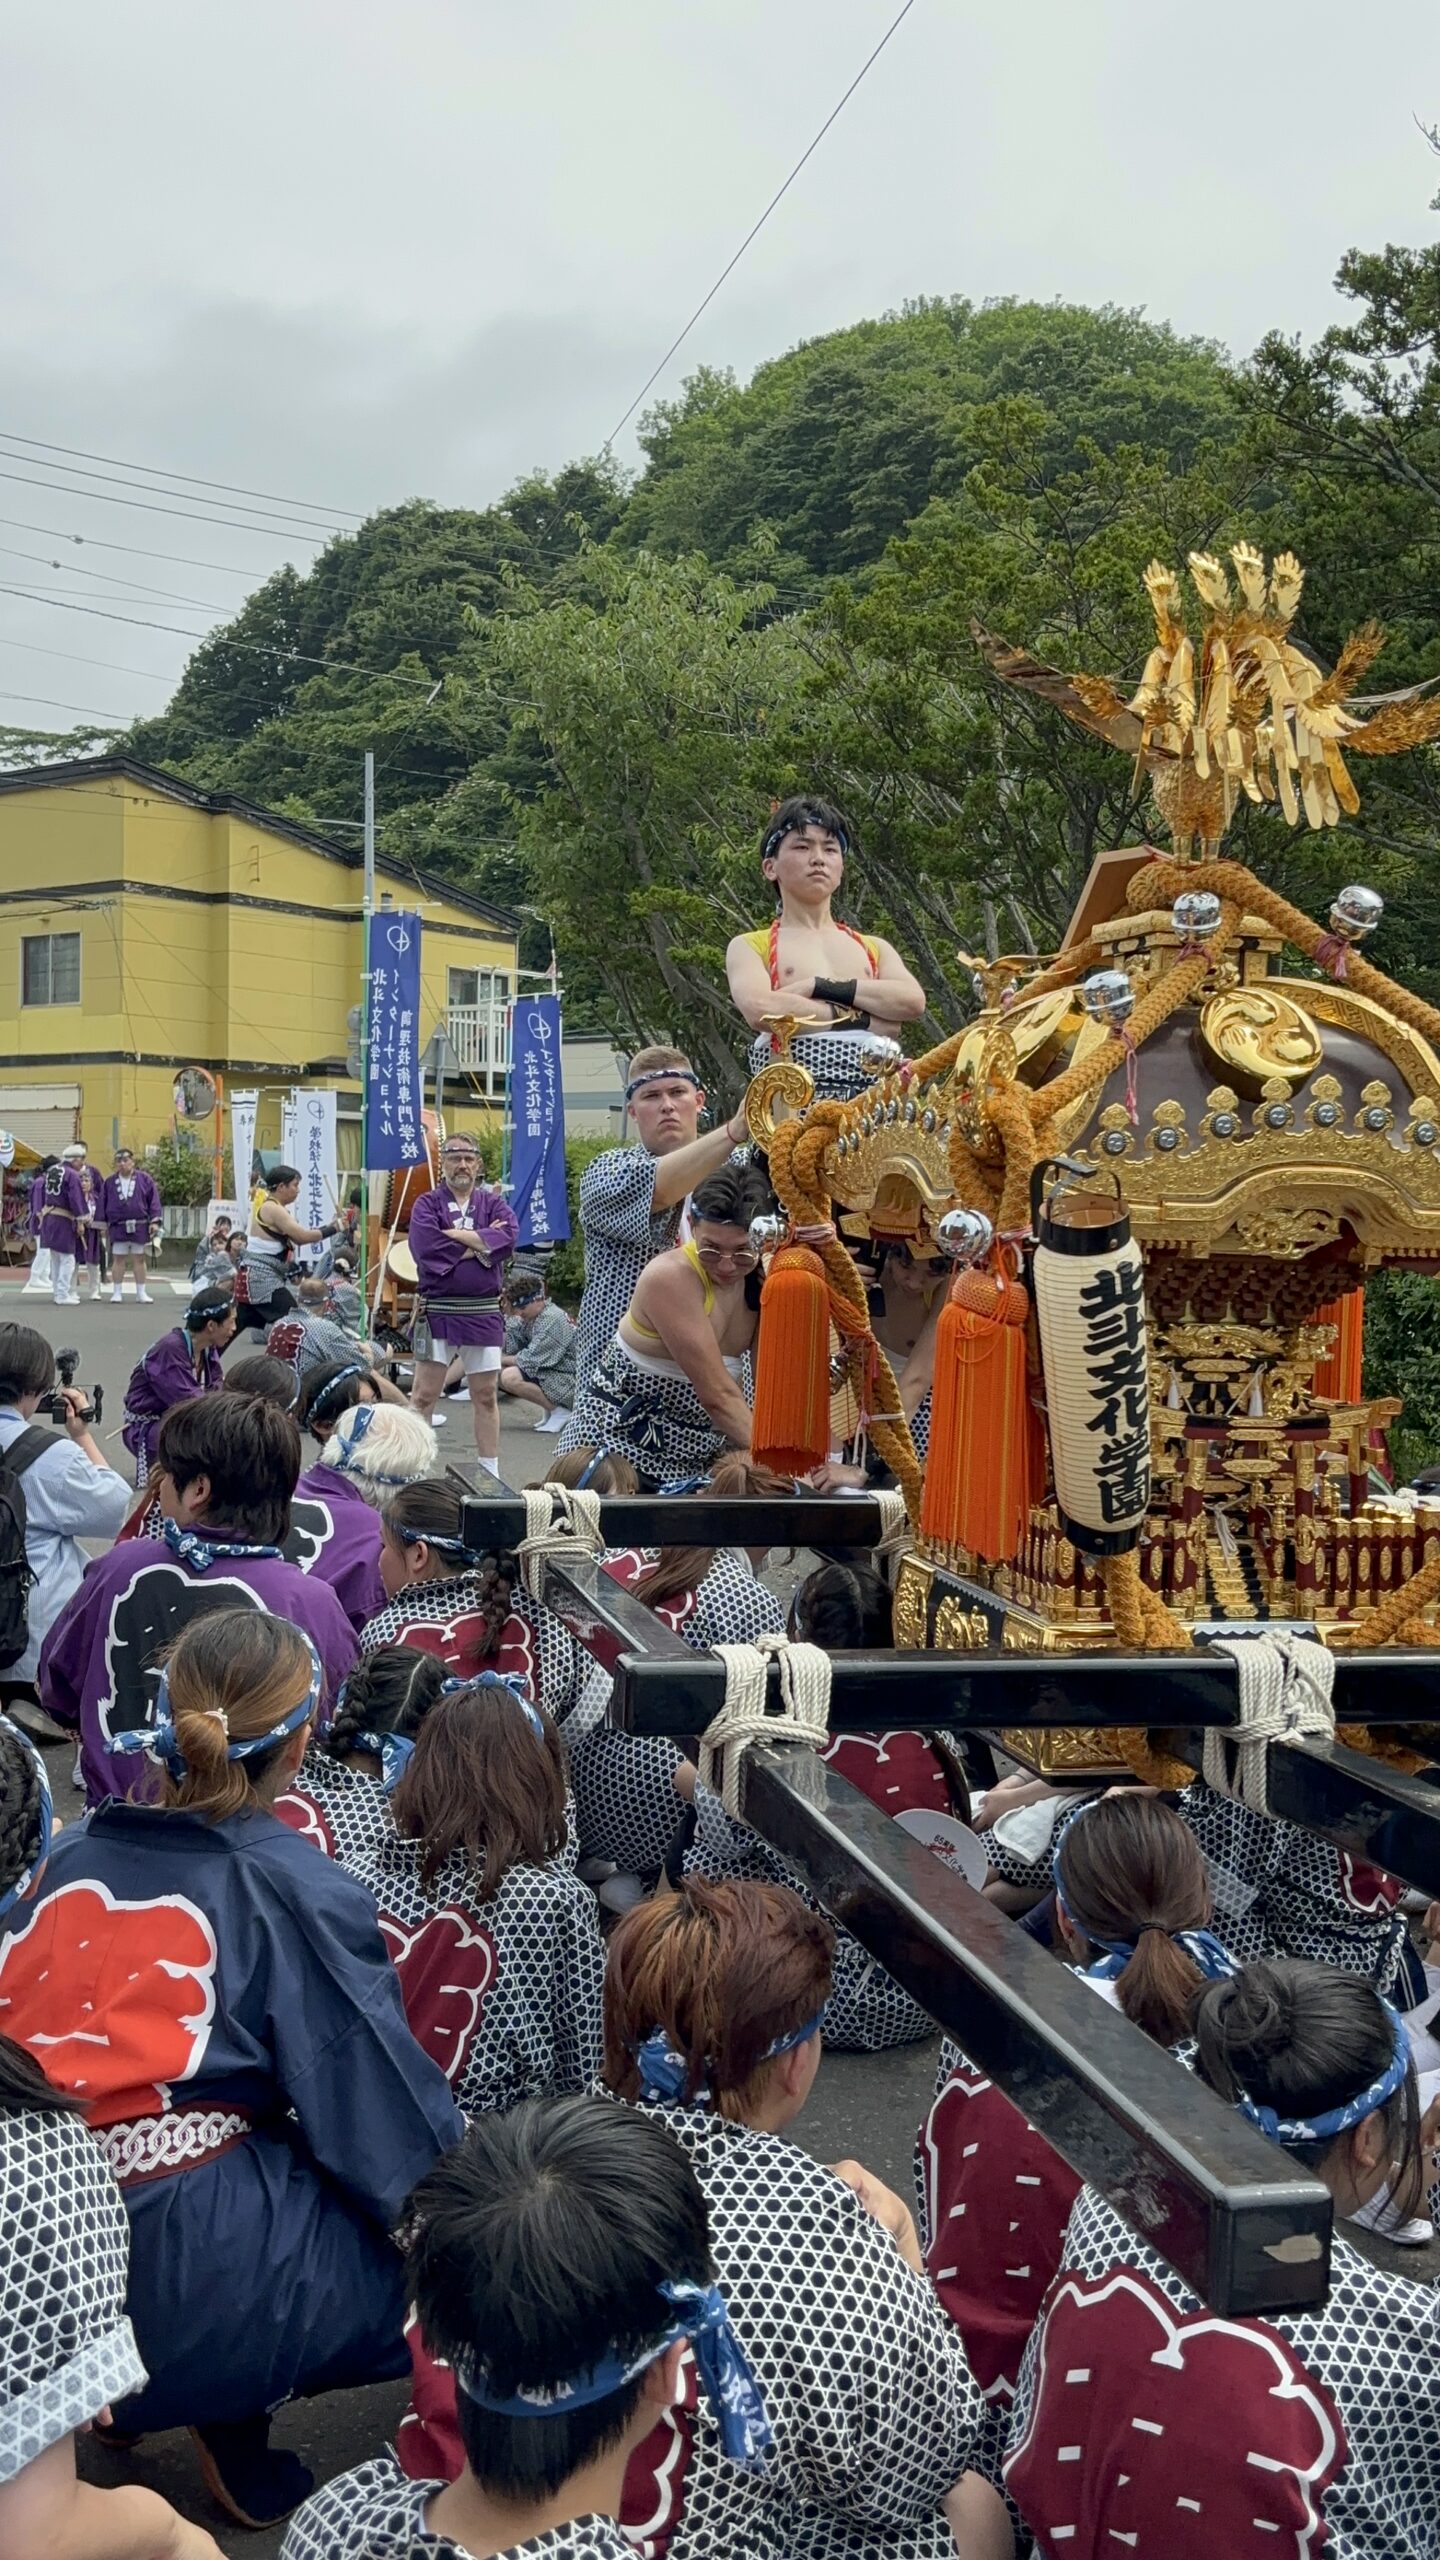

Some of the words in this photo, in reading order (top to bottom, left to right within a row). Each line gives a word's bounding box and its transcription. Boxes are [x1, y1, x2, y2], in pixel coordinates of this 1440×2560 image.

[1079, 1261, 1150, 1523] 北斗文化学園
